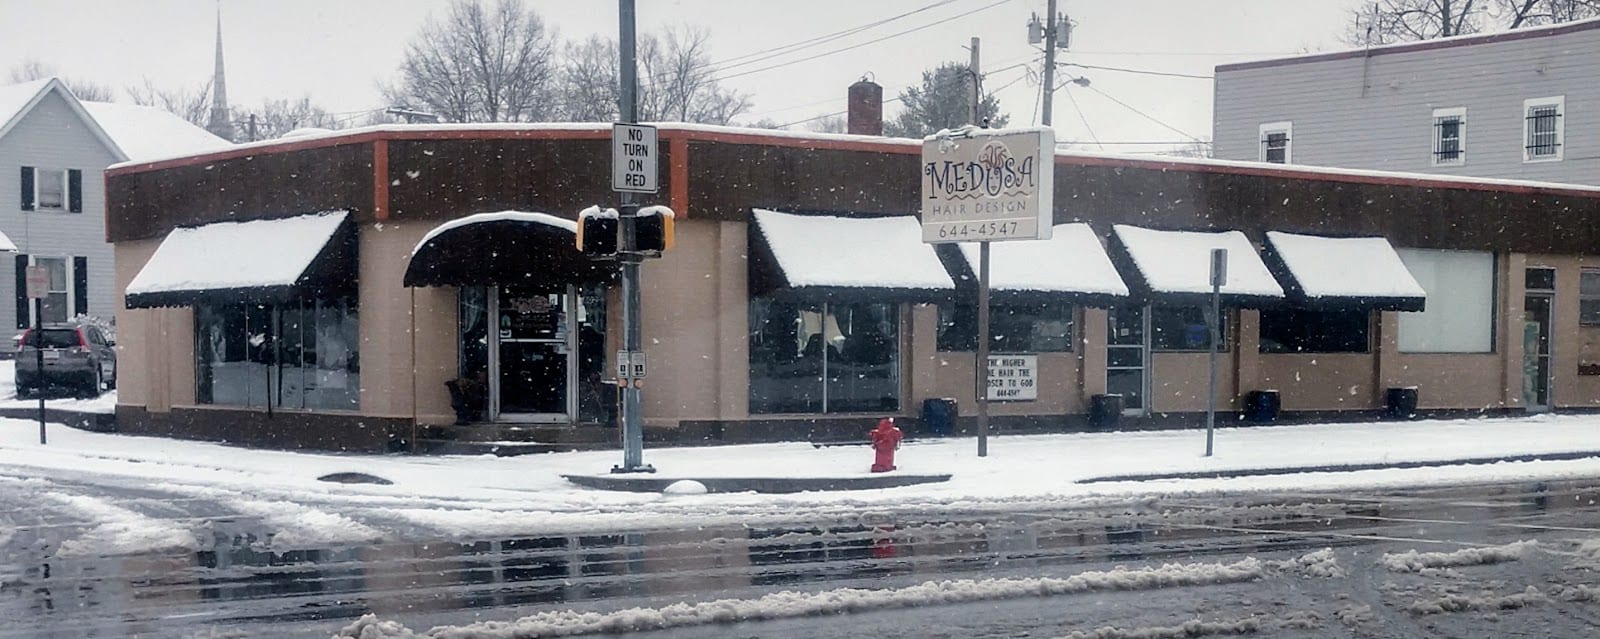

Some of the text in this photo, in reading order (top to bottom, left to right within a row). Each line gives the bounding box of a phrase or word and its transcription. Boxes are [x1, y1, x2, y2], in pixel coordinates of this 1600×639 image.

[628, 129, 643, 141] NO
[622, 143, 649, 157] TURN
[628, 159, 643, 172] ON
[625, 173, 646, 187] RED
[924, 155, 1034, 199] MEDUSA
[932, 200, 1026, 216] HAIR DESIGN
[939, 222, 1018, 238] 644-4547
[1002, 359, 1026, 367] HIGHER
[998, 369, 1013, 377] HAIR
[1018, 369, 1030, 377] THE
[1008, 379, 1016, 387] TO
[1020, 379, 1033, 388] GOD
